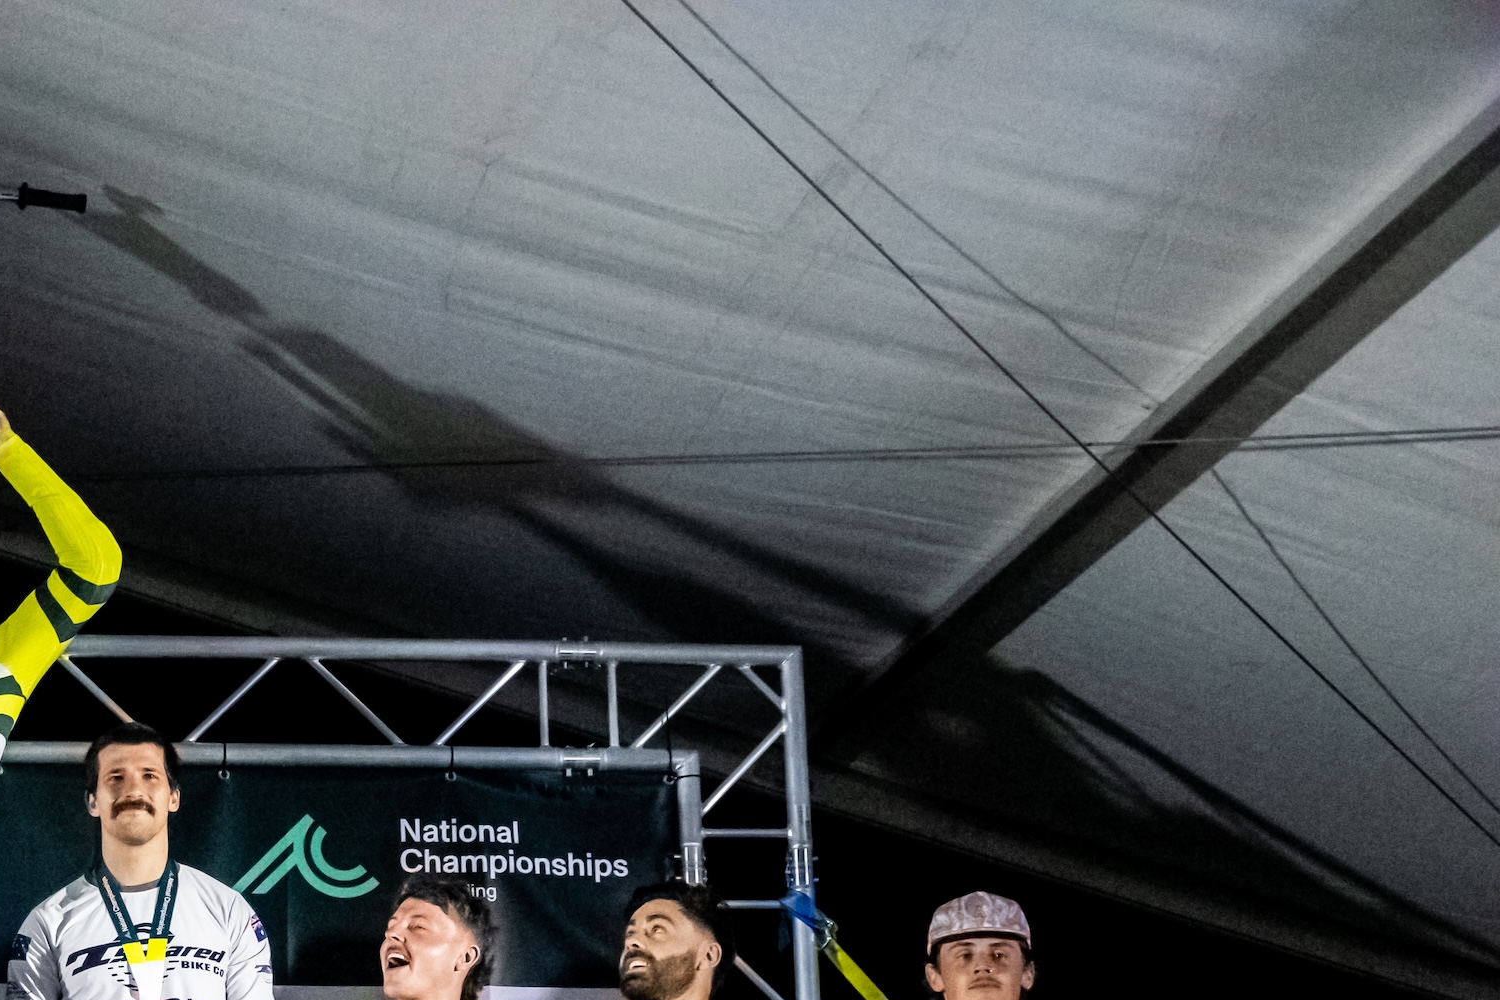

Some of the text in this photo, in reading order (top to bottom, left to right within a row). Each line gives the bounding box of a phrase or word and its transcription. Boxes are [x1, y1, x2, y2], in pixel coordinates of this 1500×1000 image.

[400, 818, 520, 845] National
[400, 848, 629, 882] Championships
[181, 960, 225, 978] BIKE CO
